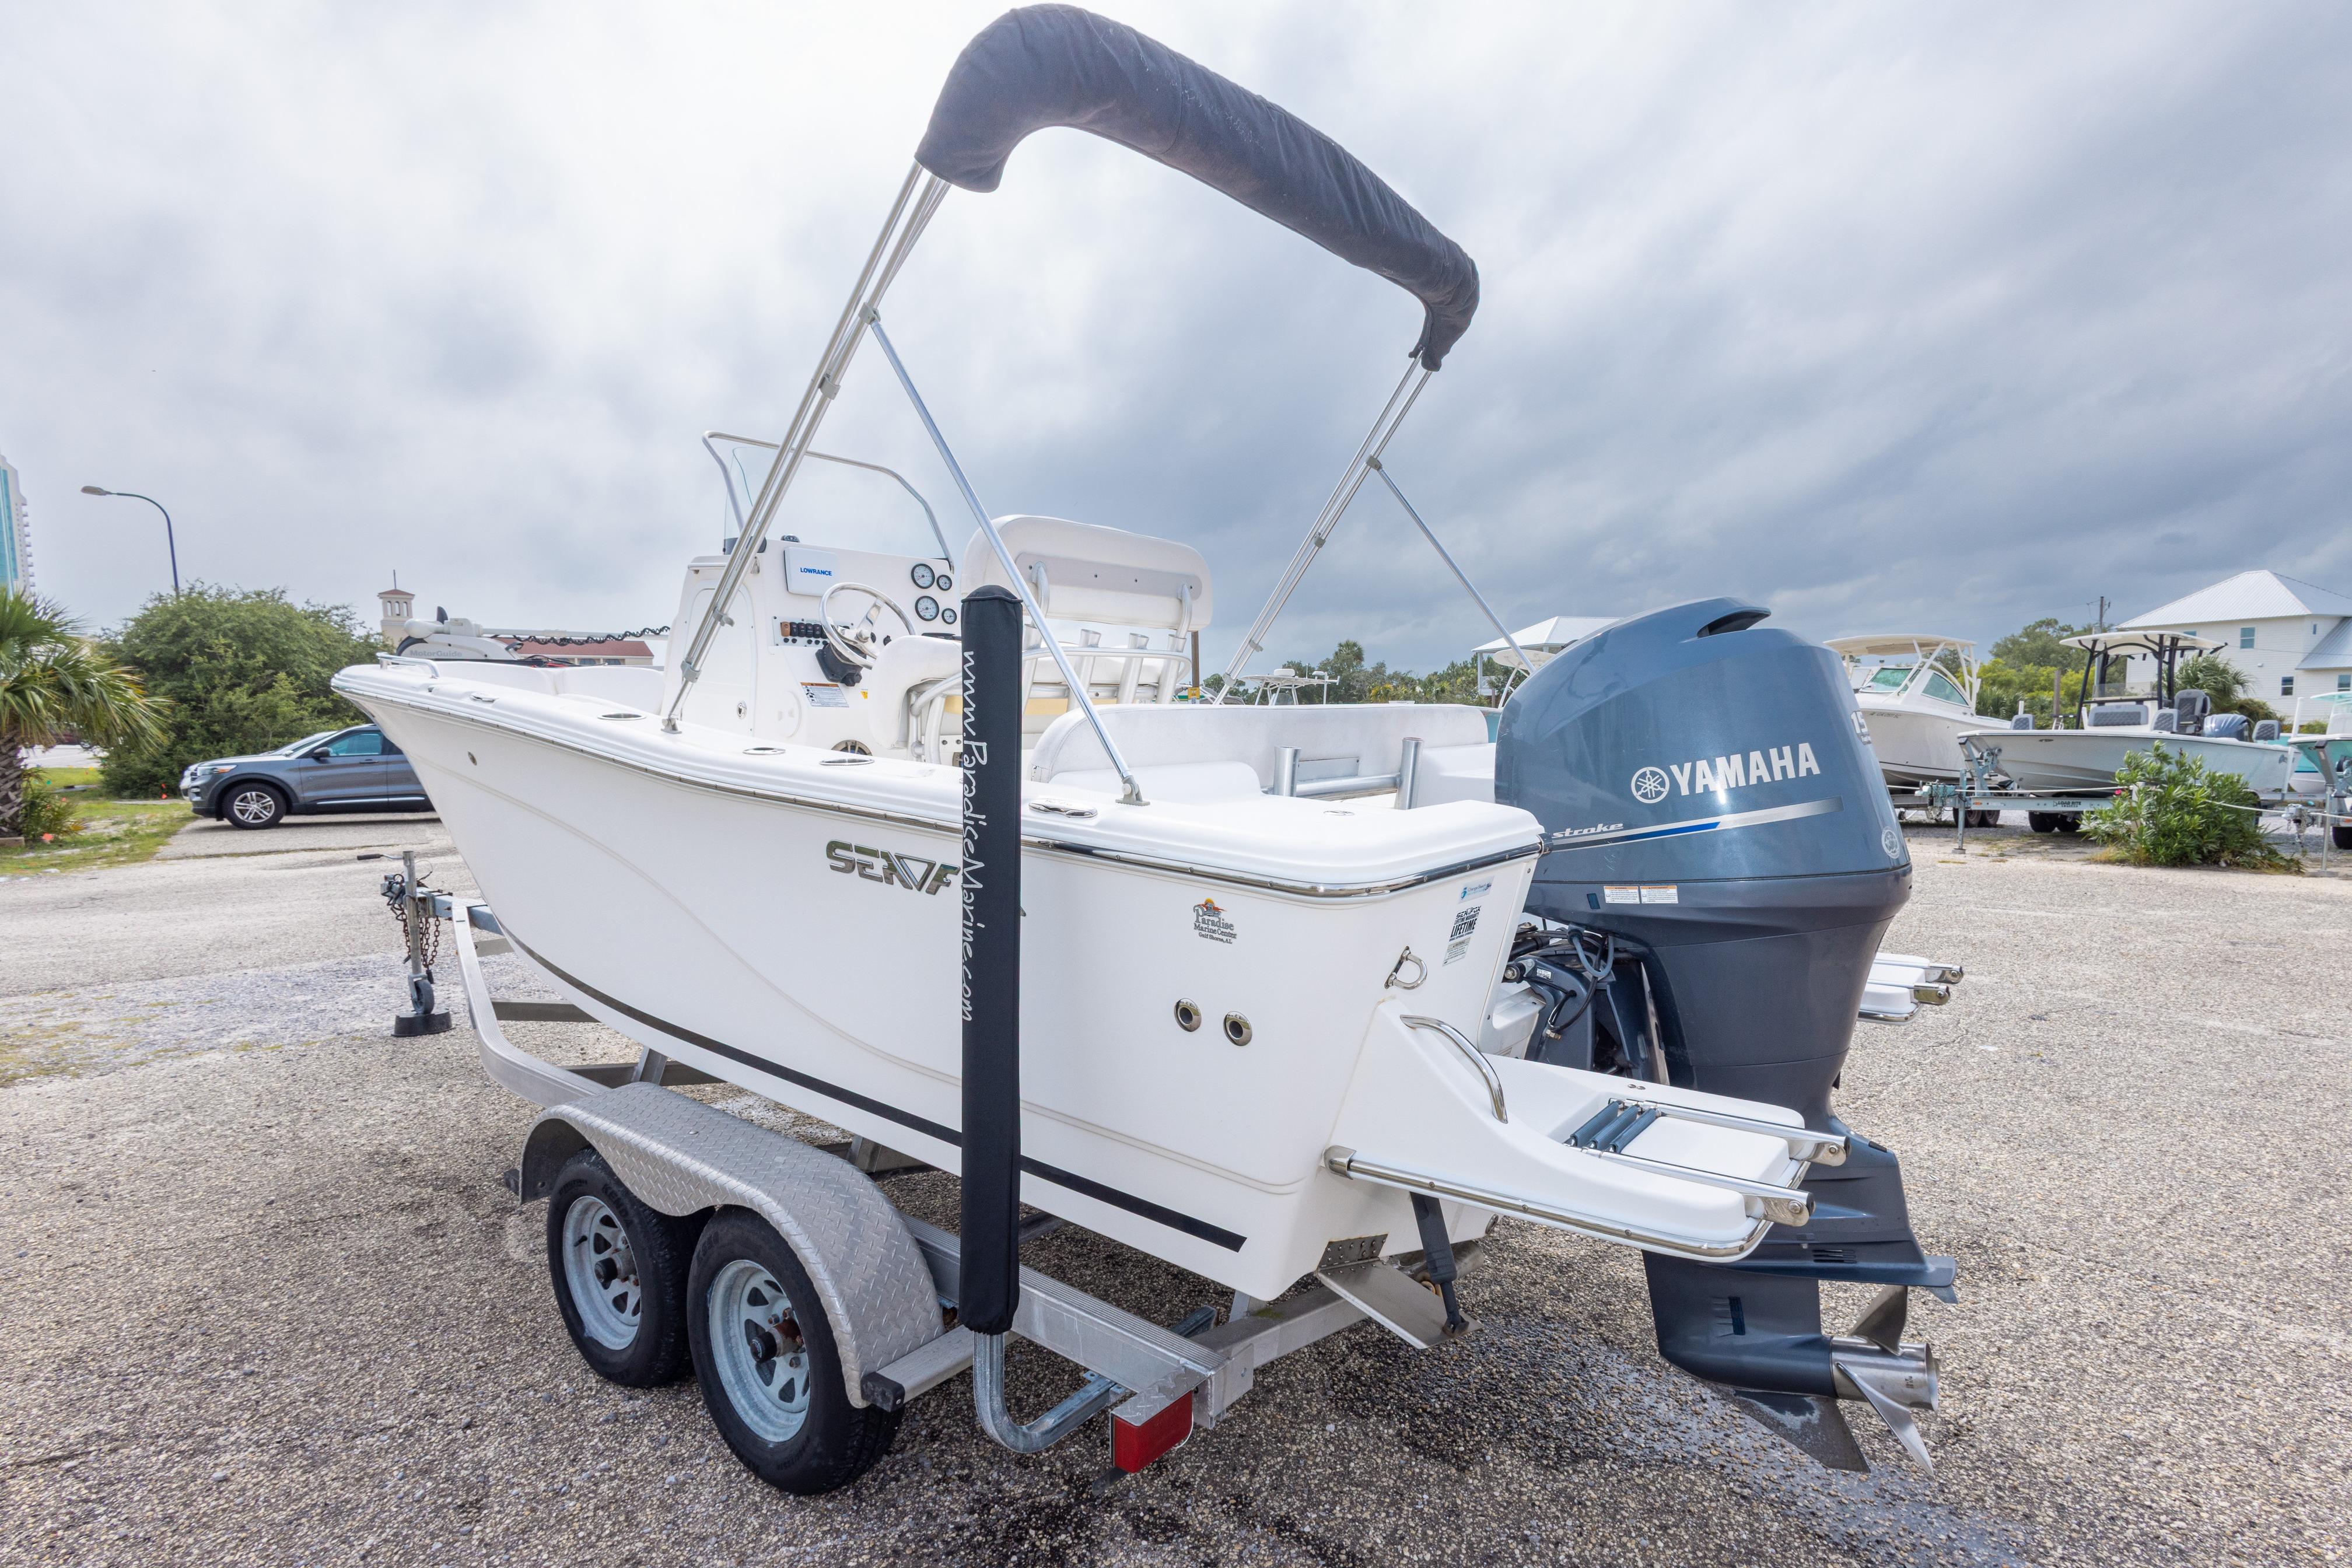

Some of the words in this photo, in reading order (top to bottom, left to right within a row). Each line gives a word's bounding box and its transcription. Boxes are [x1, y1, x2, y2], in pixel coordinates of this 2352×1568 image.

[800, 567, 832, 576] LOWRANCE
[1670, 743, 1821, 796] YAMAHA
[962, 650, 988, 1022] www.ParadiseMarine.com
[1552, 822, 1624, 839] stroke
[1193, 905, 1234, 931] Paradise
[1454, 916, 1466, 925] LIFETIME
[1465, 912, 1479, 921] WARRANTY
[1194, 922, 1217, 935] Marine
[1217, 928, 1237, 939] Center
[1450, 918, 1478, 938] LIFETIME
[1209, 934, 1225, 943] Shores,
